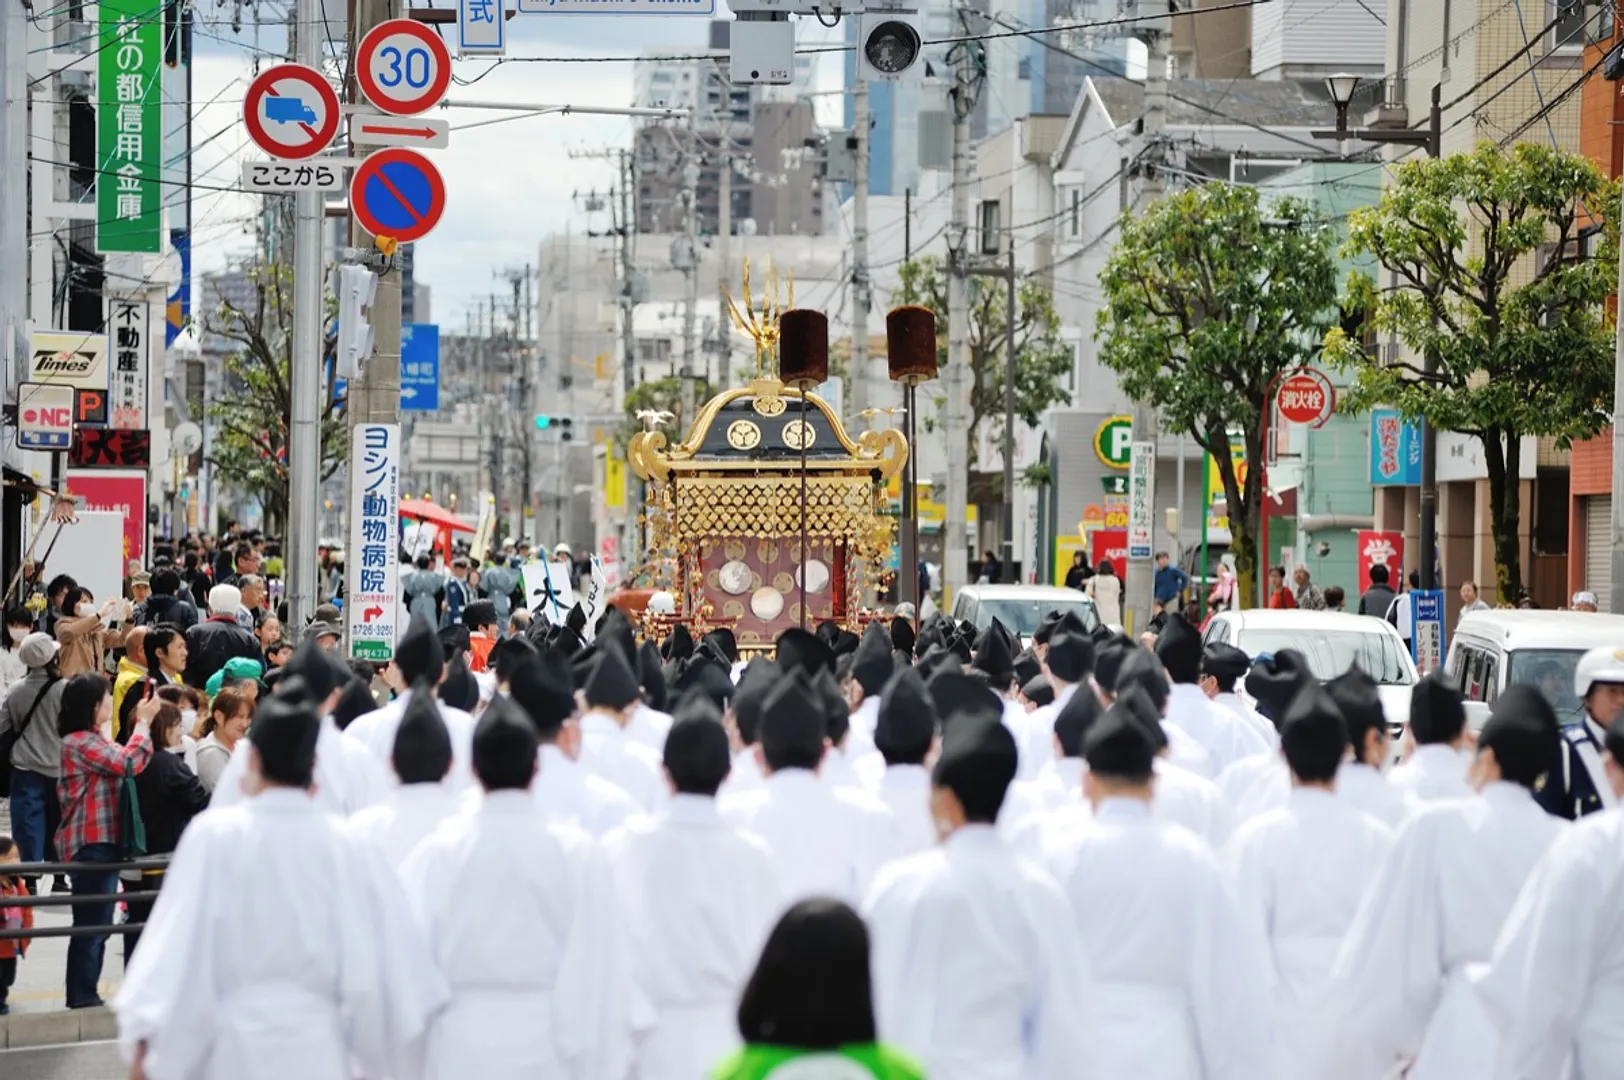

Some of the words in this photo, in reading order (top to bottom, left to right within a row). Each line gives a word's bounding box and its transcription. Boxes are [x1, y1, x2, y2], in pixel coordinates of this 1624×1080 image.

[378, 45, 431, 88] 30
[115, 14, 144, 221] 杜の都信用金庫
[251, 166, 336, 187] ここから
[33, 350, 97, 372] Times
[80, 392, 101, 421] P
[1280, 390, 1322, 409] 消火栓
[360, 427, 389, 593] ヨシノ動物病院
